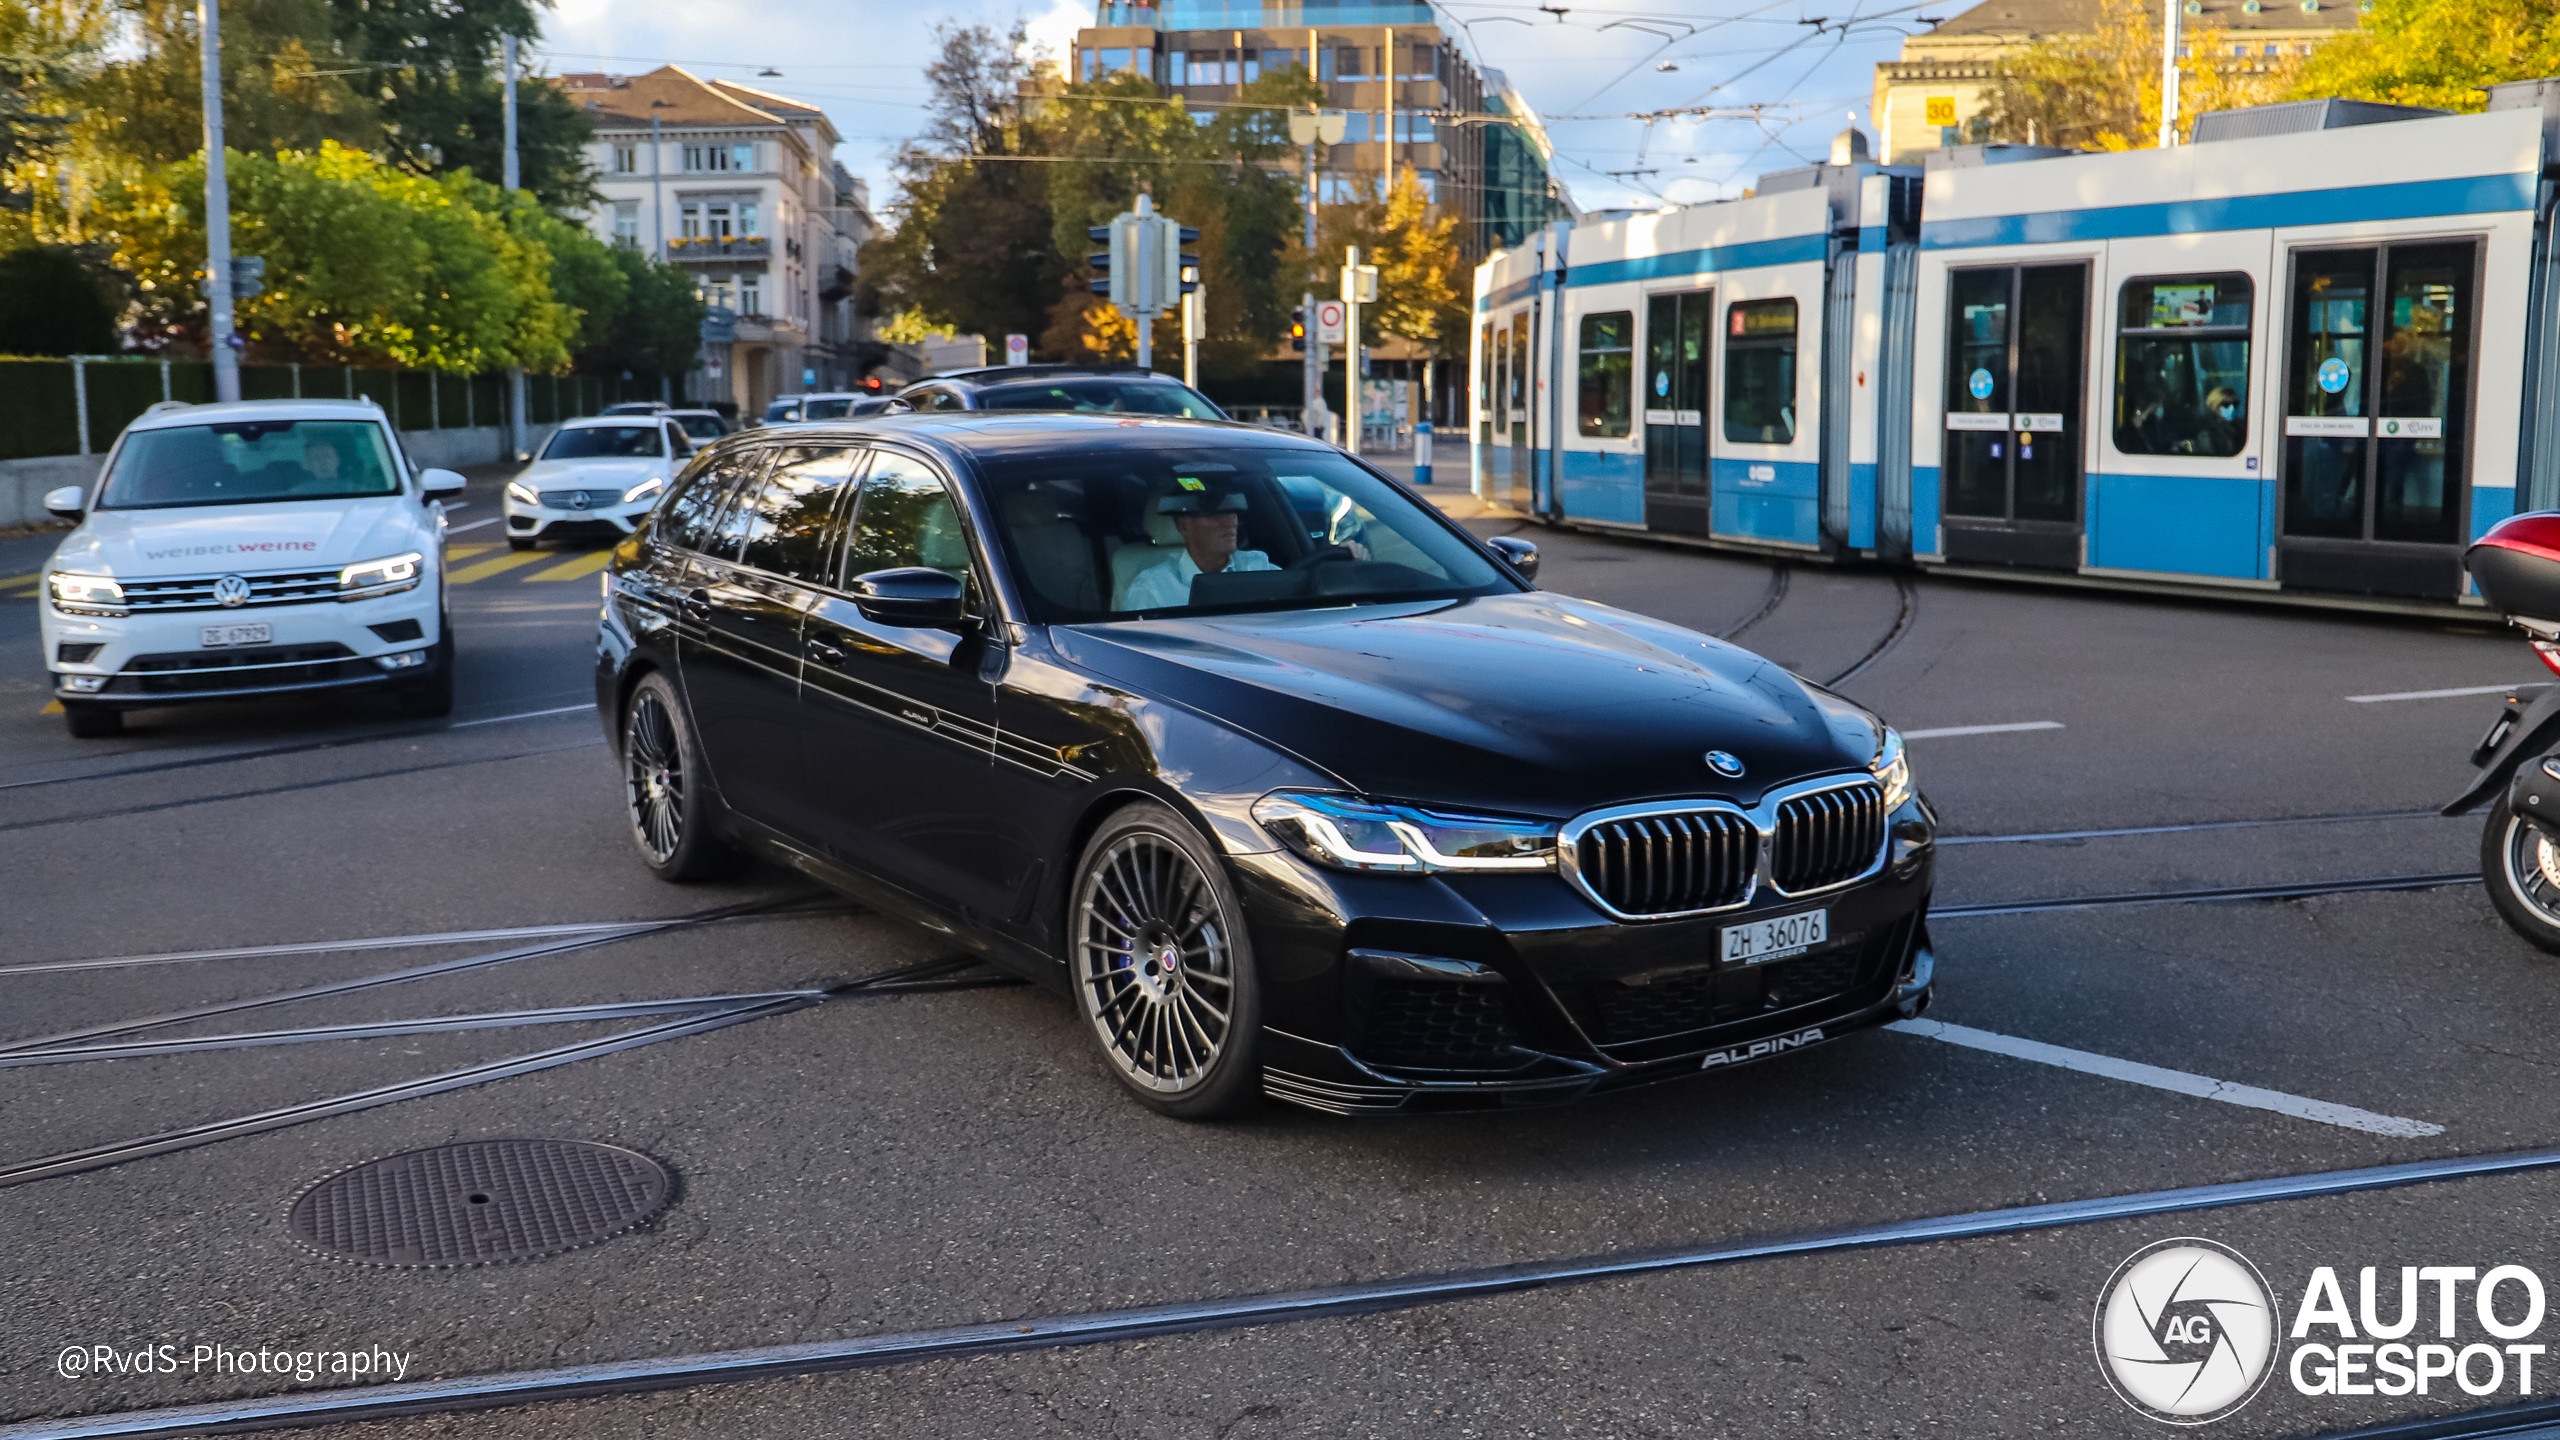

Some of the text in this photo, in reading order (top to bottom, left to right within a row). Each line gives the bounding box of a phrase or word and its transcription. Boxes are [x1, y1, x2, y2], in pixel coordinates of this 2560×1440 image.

[1928, 102, 1954, 120] 30
[1729, 913, 1820, 958] ZH 36076
[1701, 1028, 1825, 1069] ALPINA
